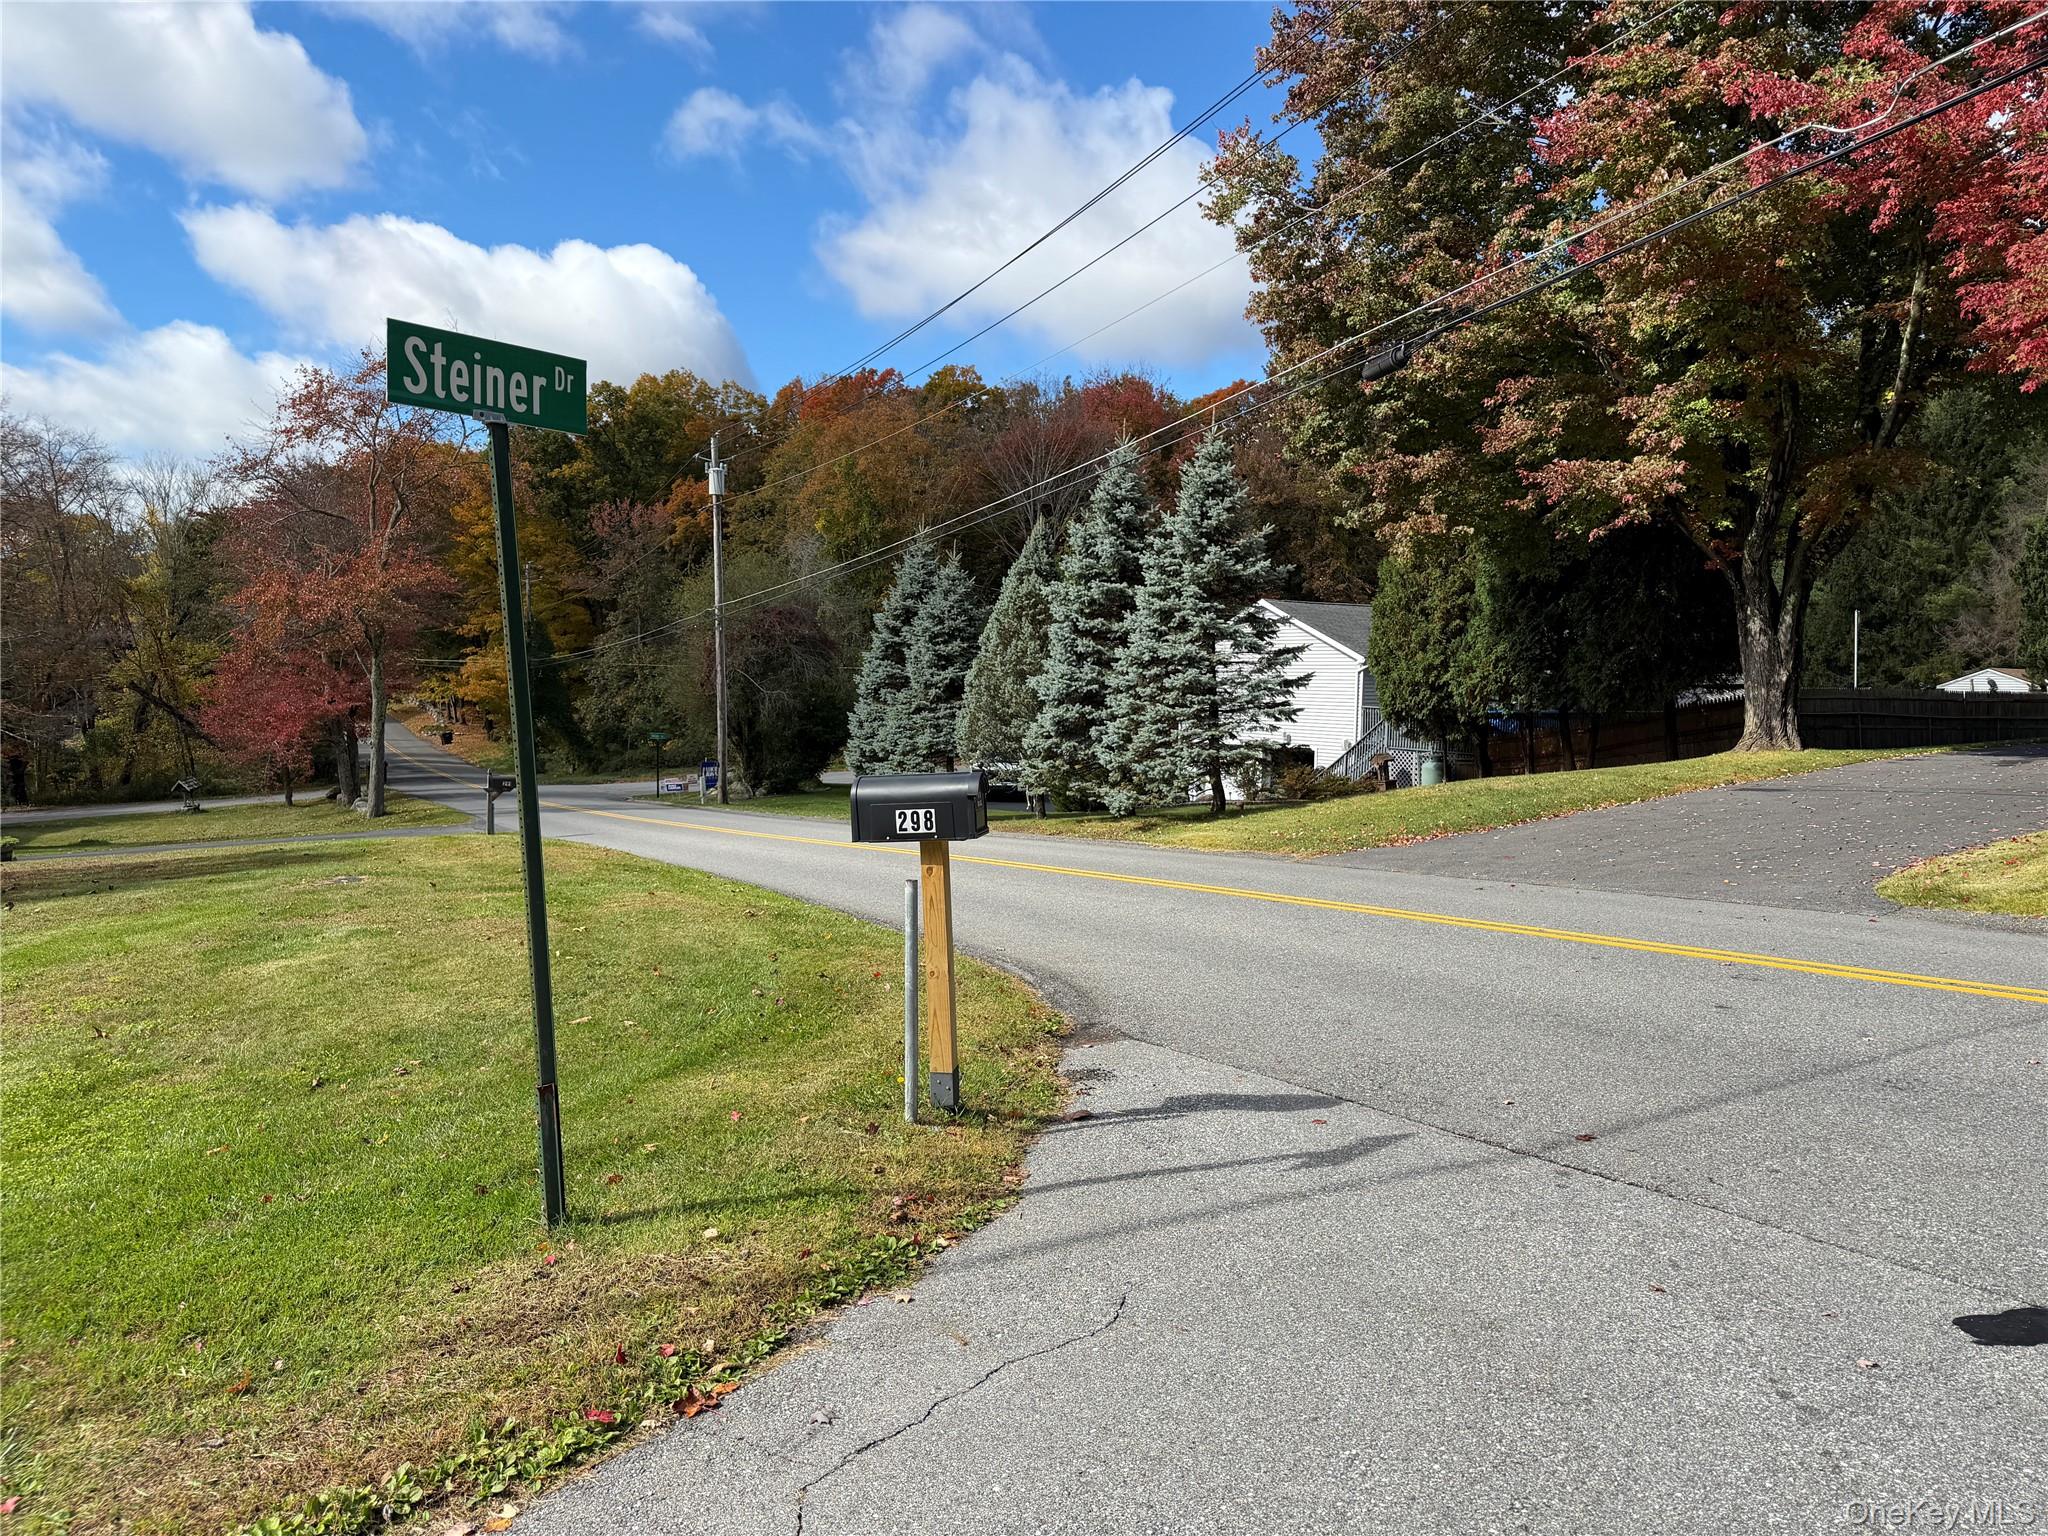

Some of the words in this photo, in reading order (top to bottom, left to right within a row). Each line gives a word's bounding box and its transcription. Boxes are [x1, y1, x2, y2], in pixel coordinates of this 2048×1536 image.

[403, 335, 547, 416] Steiner
[554, 366, 575, 393] Dr
[897, 809, 935, 833] 298
